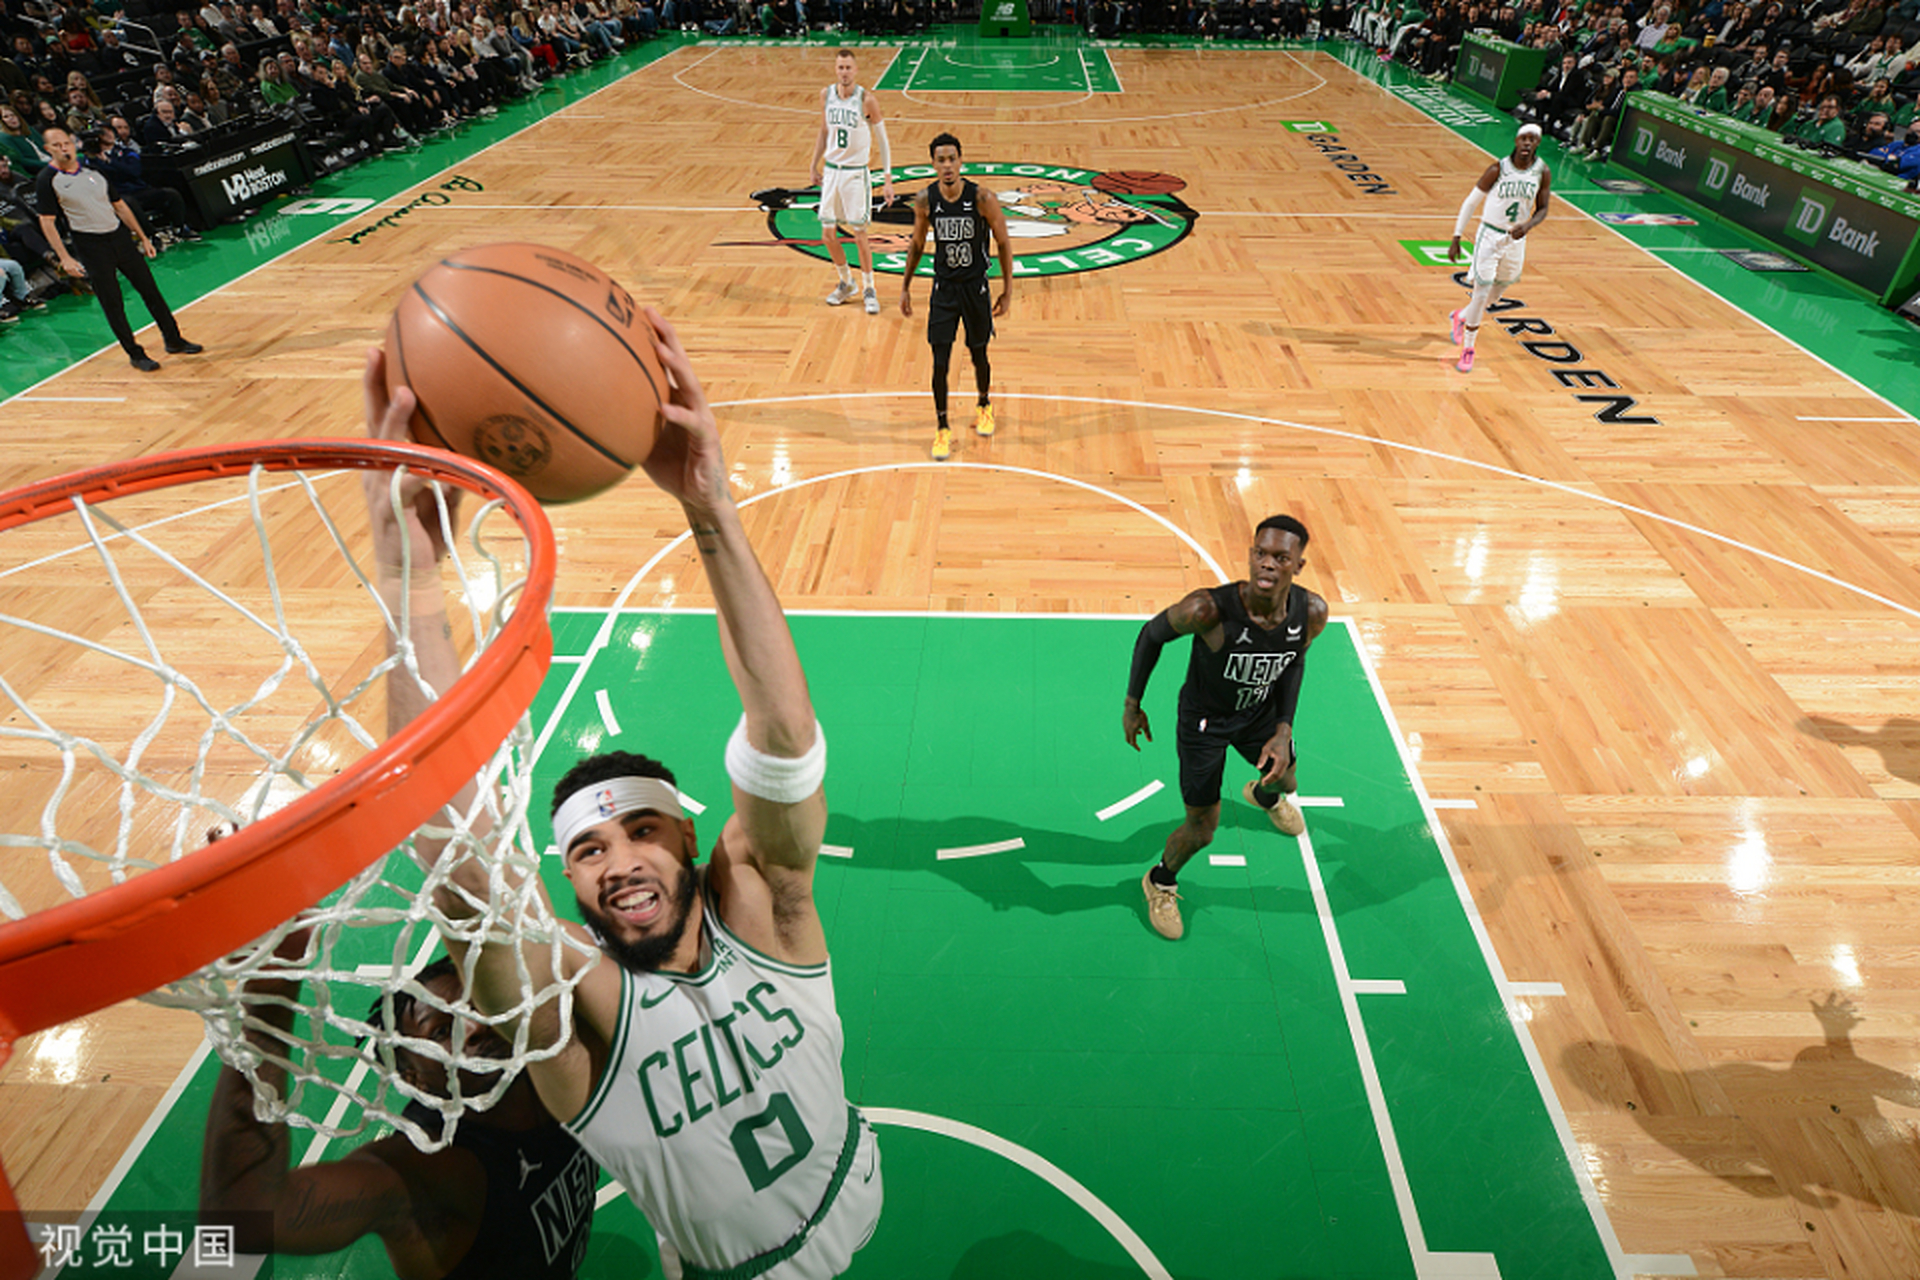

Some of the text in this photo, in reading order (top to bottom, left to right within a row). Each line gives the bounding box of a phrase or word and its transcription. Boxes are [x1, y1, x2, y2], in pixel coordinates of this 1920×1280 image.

[837, 129, 848, 148] 8
[1634, 126, 1687, 170] TD Bank
[249, 169, 288, 196] BOSTON
[1306, 134, 1399, 195] GARDEN
[1705, 157, 1730, 191] TD
[1731, 173, 1771, 208] Bank
[1505, 202, 1520, 222] 4
[1796, 196, 1881, 258] TD Bank
[729, 1091, 815, 1194] 0
